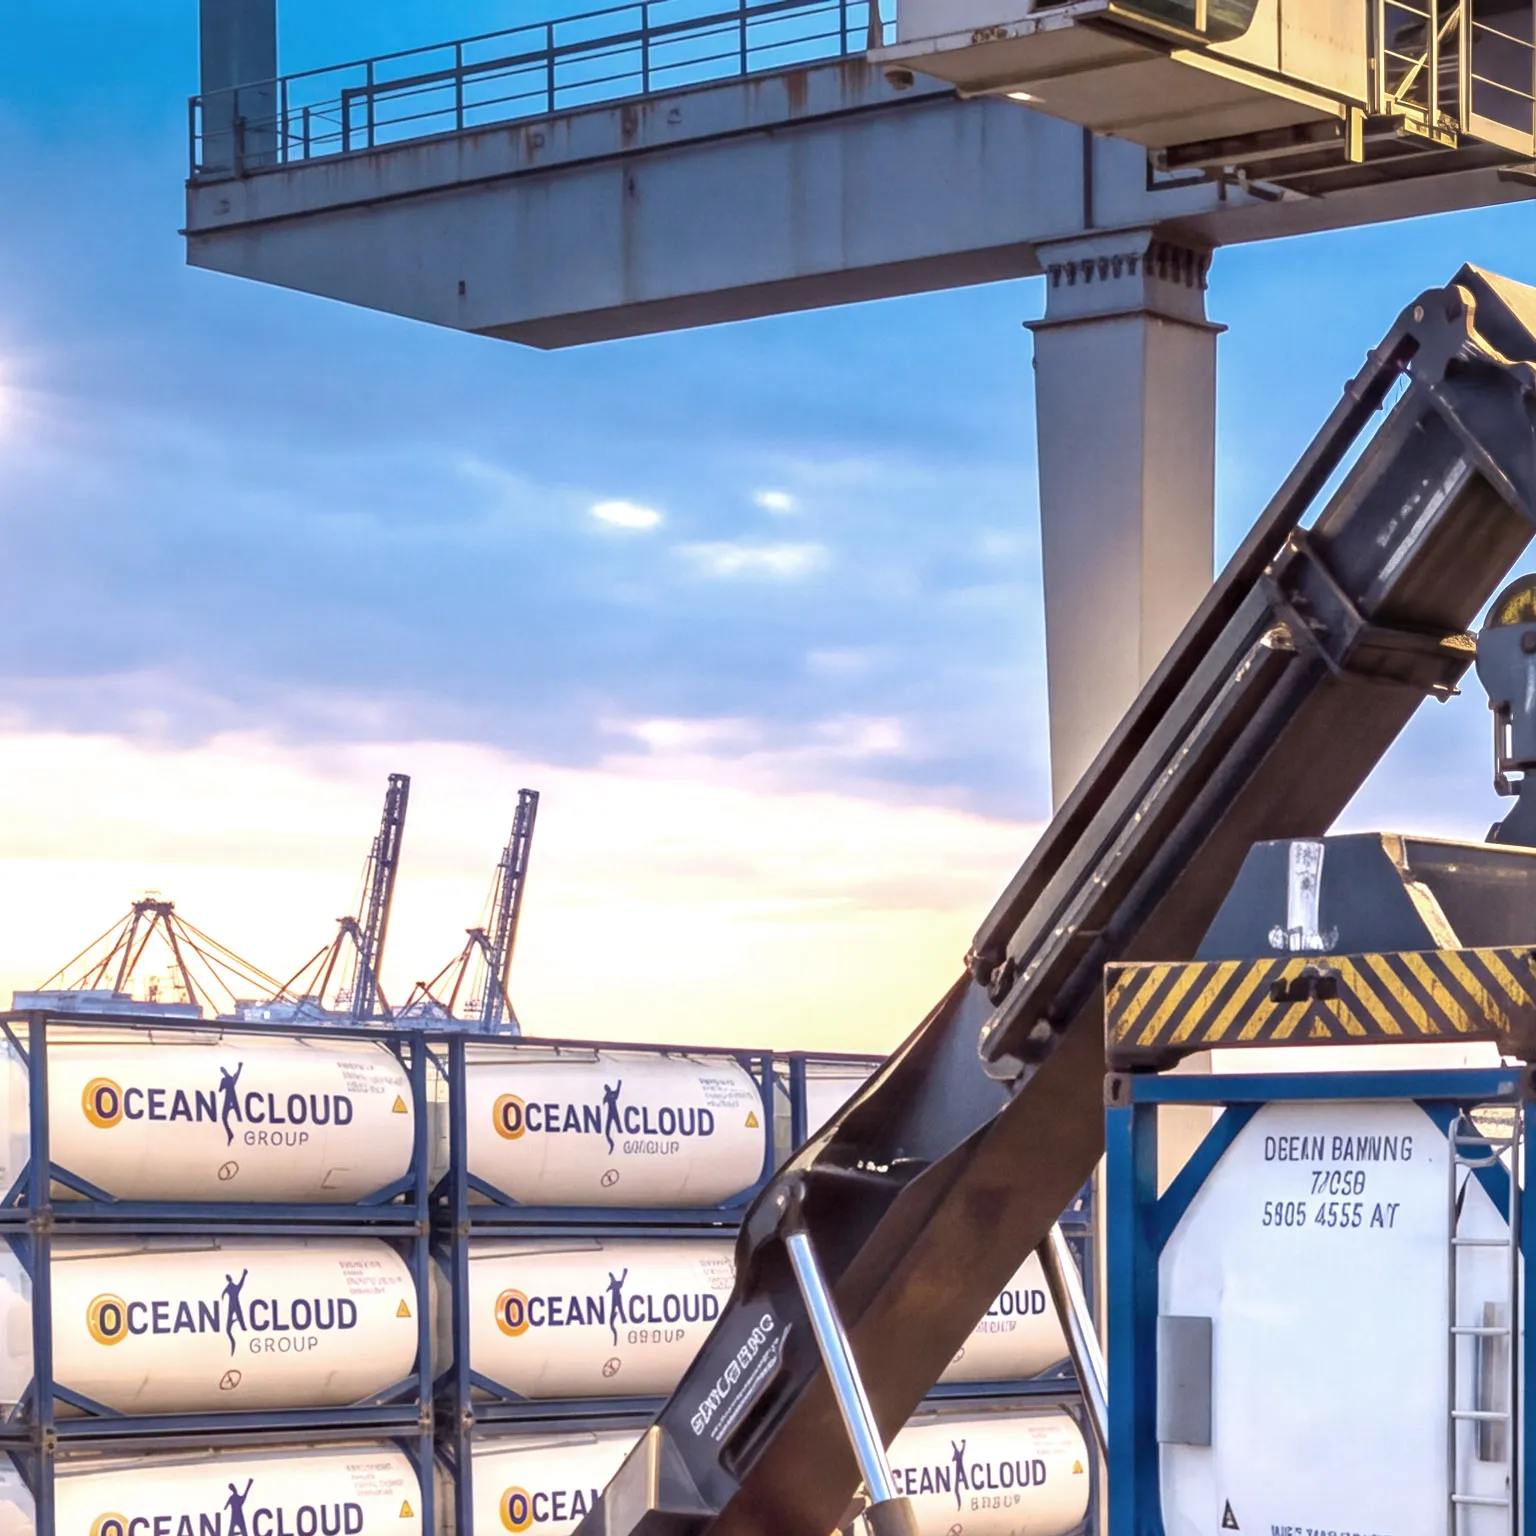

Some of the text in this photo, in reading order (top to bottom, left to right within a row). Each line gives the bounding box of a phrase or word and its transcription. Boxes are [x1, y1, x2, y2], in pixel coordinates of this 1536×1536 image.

[95, 1086, 353, 1126] OCEAN CLOUD
[502, 1101, 715, 1137] OCEAN CLOUD
[244, 1130, 309, 1147] GROUP
[100, 1298, 357, 1336] OCEAN CLOUD
[505, 1293, 719, 1328] OCEAN CLOUD
[250, 1336, 318, 1354] GROUP
[892, 1459, 1046, 1495] CEAN CLOUD
